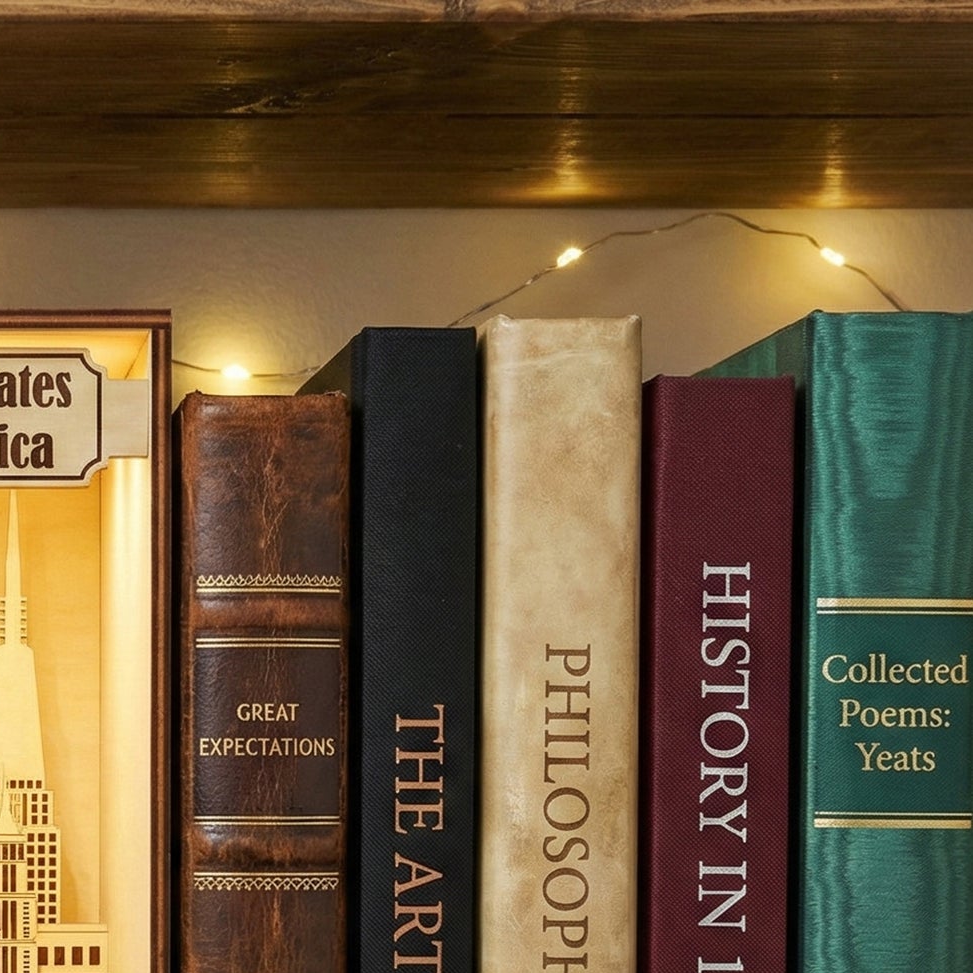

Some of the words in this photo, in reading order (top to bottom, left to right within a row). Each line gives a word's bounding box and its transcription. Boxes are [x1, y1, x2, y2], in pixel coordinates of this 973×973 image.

[822, 653, 969, 685] Collected
[236, 703, 300, 723] GREAT
[698, 561, 751, 843] HISTORY
[839, 698, 951, 729] Poems:
[199, 738, 336, 758] EXPECTATIONS
[855, 742, 936, 772] Yeats
[394, 704, 445, 834] THE
[696, 860, 748, 931] IN
